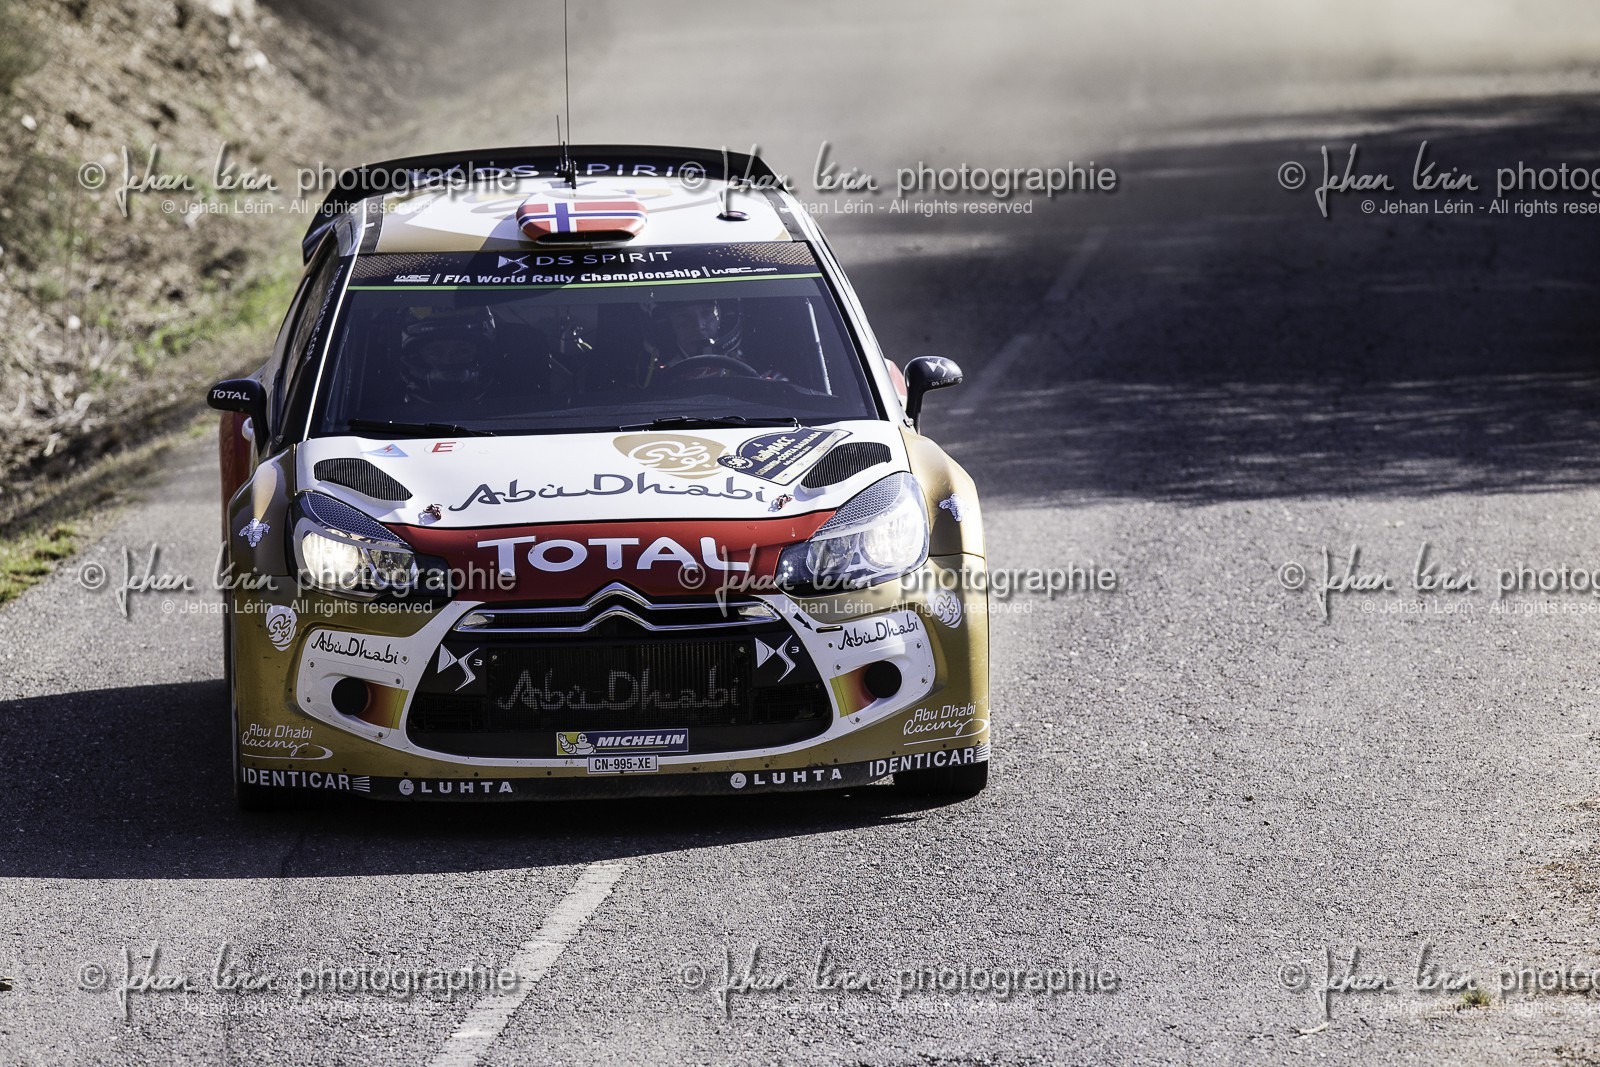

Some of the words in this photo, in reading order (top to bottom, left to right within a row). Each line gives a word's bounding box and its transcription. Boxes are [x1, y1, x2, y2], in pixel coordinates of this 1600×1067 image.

[554, 163, 706, 177] PIRIT
[536, 256, 574, 266] DS
[583, 251, 672, 264] SPIRIT
[443, 275, 470, 283] FIA
[477, 275, 526, 283] World
[532, 274, 575, 283] Rally
[580, 269, 701, 282] Championship
[212, 389, 250, 400] TOTAL
[431, 441, 457, 453] E
[477, 535, 750, 578] TOTAL
[914, 708, 938, 722] Abu
[940, 702, 977, 719] Dhabi
[249, 723, 271, 737] Abu
[275, 725, 313, 739] Dhabi
[903, 718, 974, 736] Racing
[242, 731, 309, 757] Racing
[596, 734, 685, 747] MICHELIN
[594, 757, 651, 770] CN-995-XE
[869, 747, 975, 777] IDENTICAR
[242, 767, 350, 790] IDENTICAR
[754, 768, 842, 785] LUHTA
[421, 781, 513, 794] LUHTA
